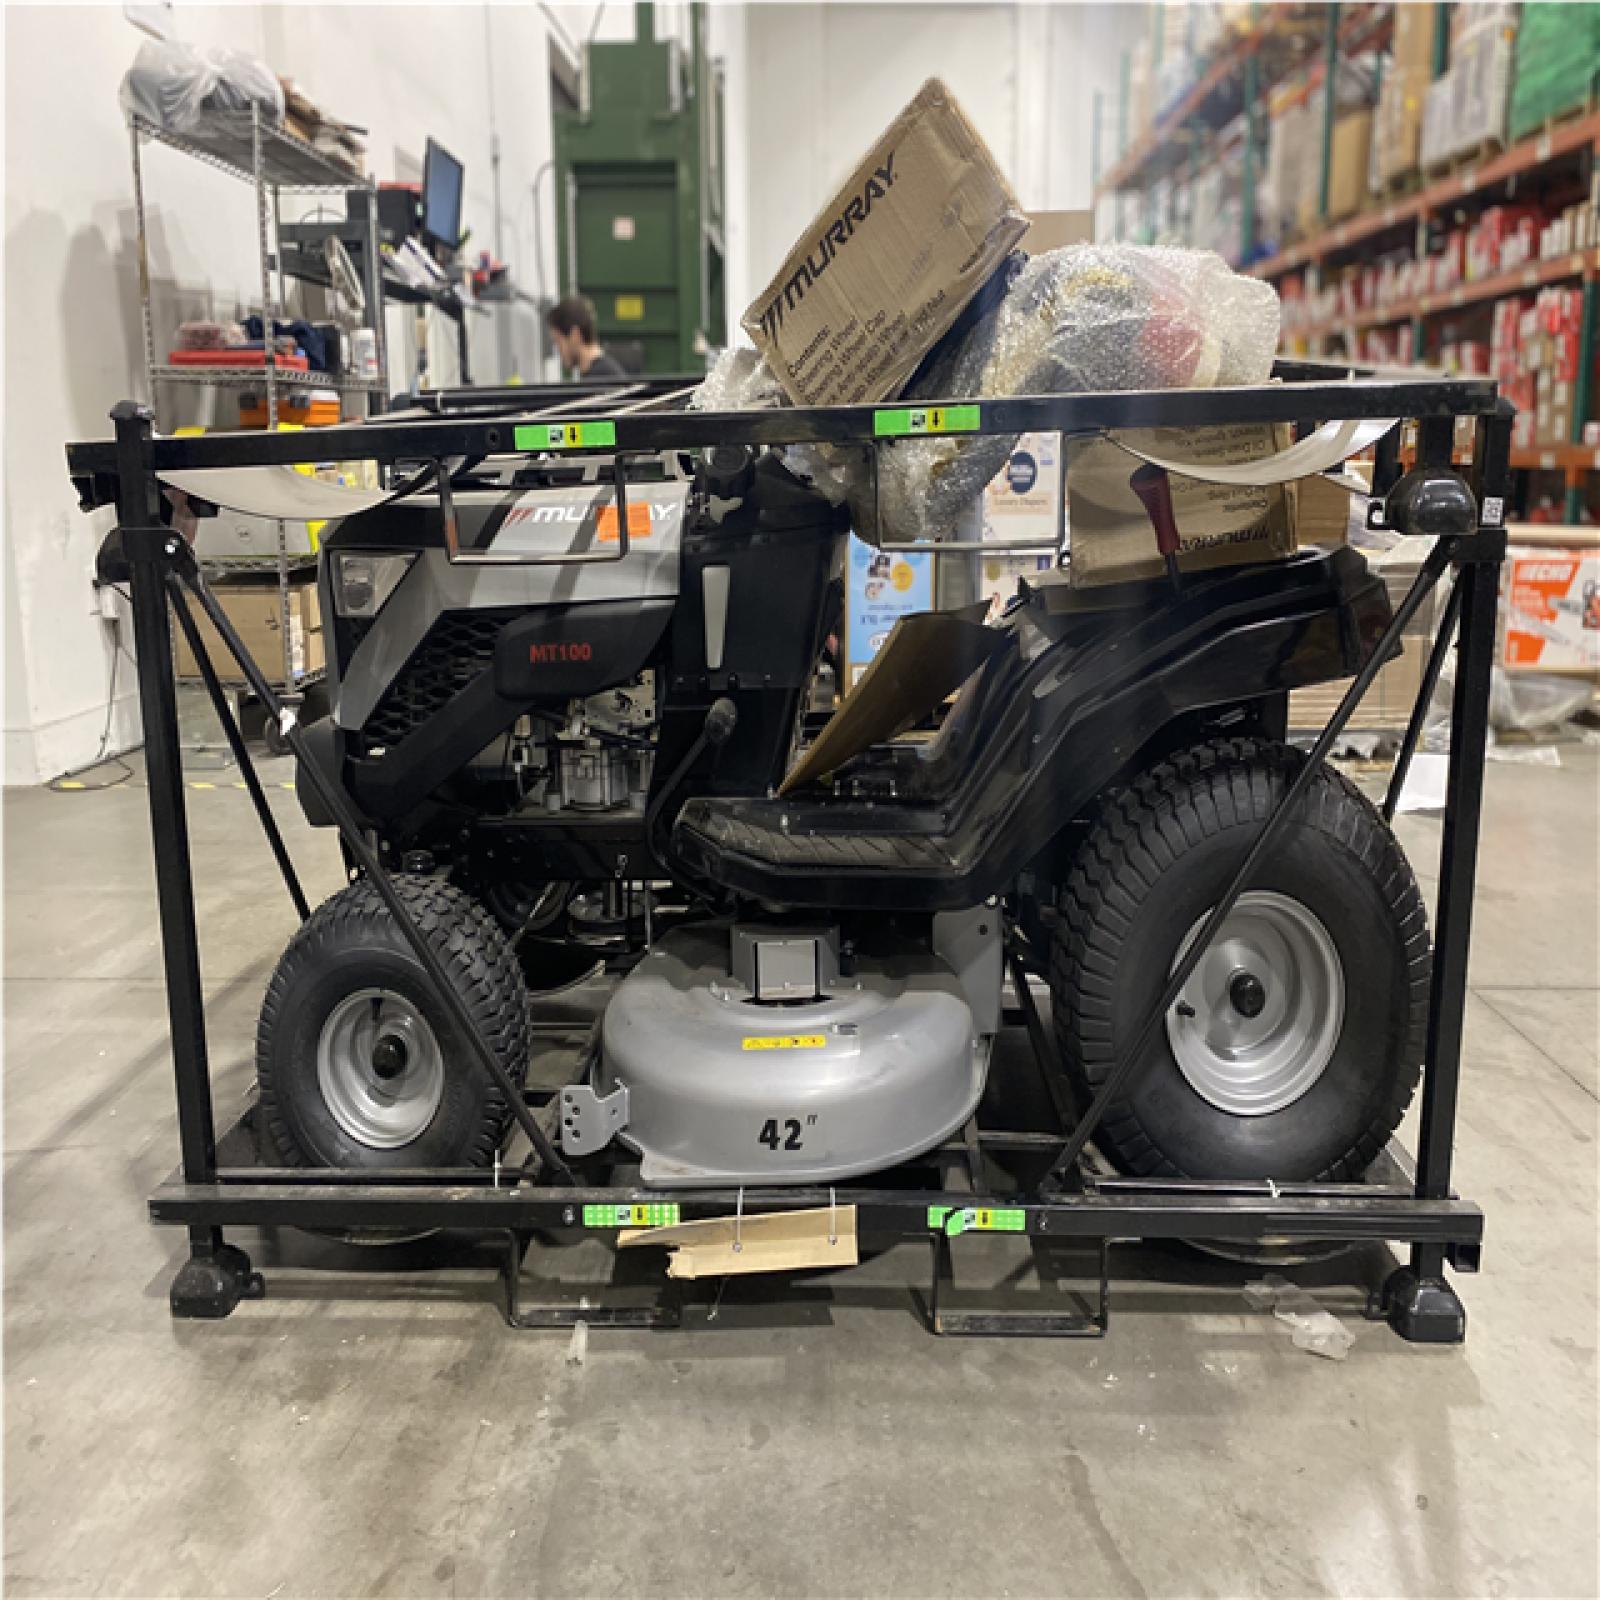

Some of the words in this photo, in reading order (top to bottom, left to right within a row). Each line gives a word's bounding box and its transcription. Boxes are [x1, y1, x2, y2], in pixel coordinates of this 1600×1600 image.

[784, 150, 896, 311] MURRAY
[786, 324, 832, 378] Contents:
[529, 642, 592, 664] MT100
